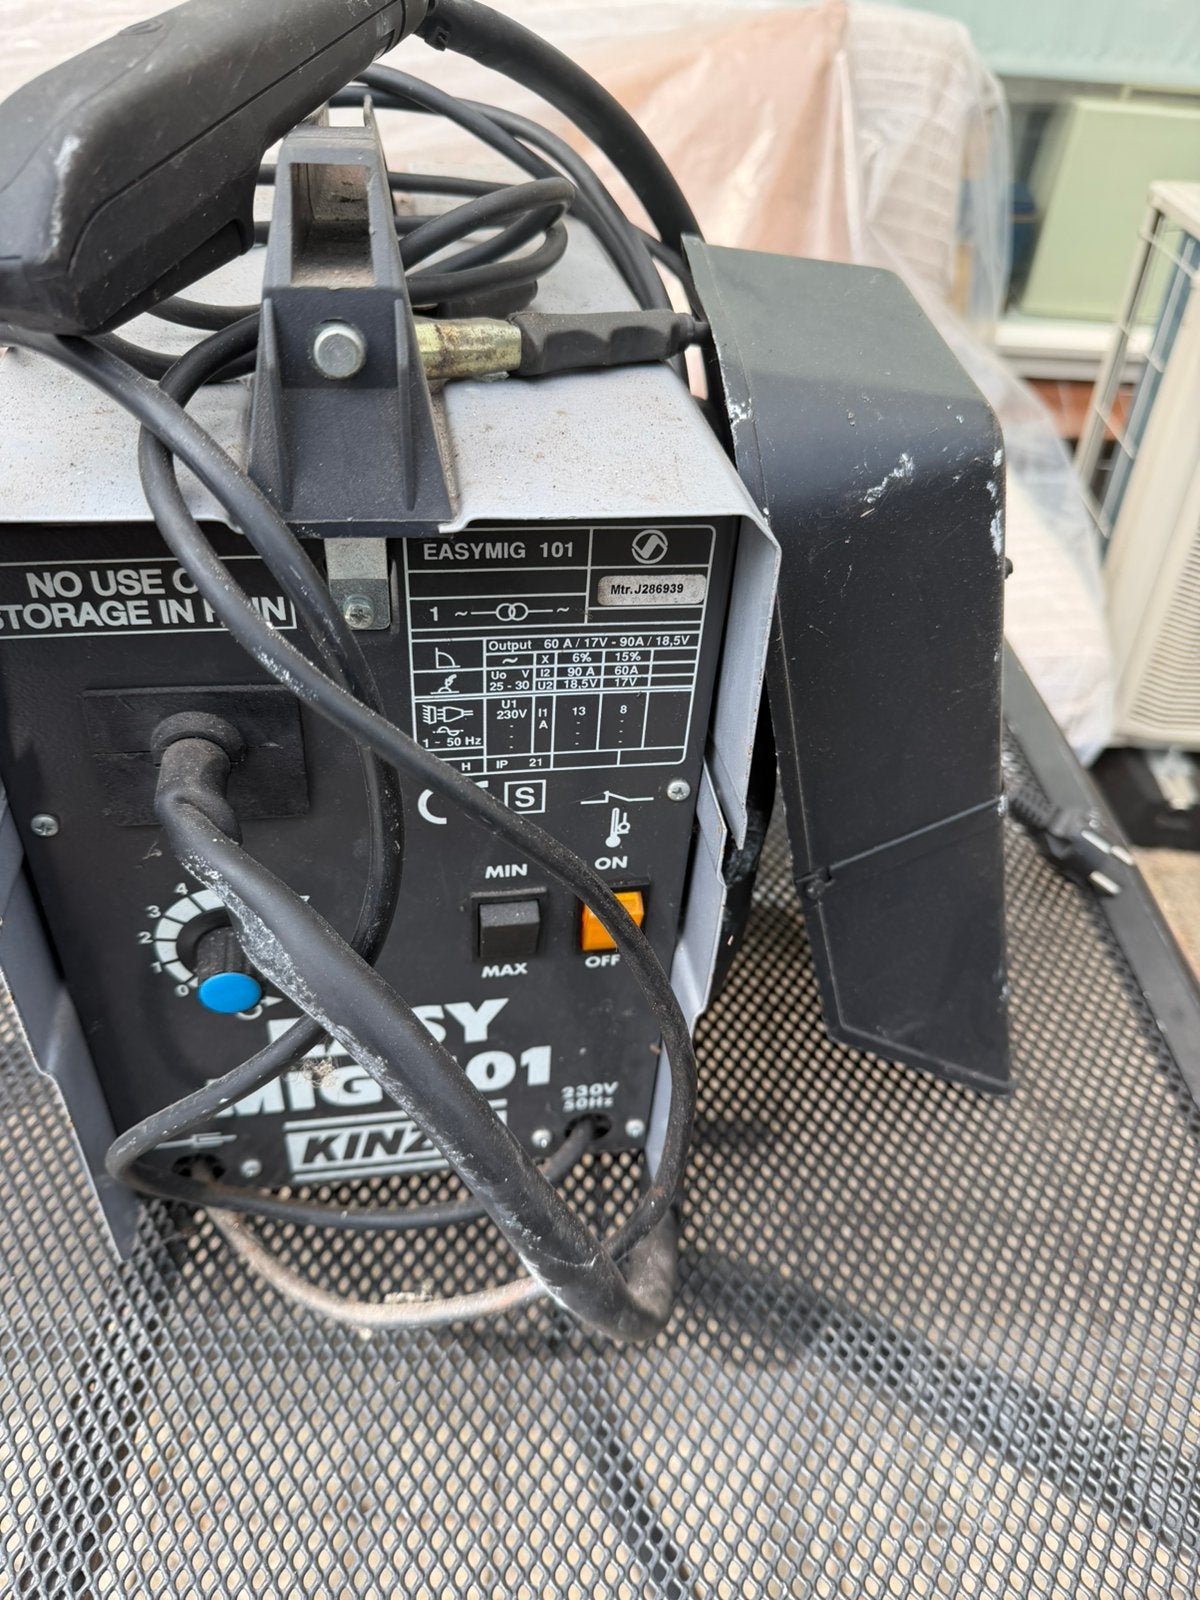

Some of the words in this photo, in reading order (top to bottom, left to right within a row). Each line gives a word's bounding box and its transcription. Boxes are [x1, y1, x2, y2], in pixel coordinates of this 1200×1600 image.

[423, 541, 526, 561] EASYMIG
[539, 541, 574, 559] 101
[26, 570, 83, 598] NO
[90, 568, 163, 597] USE
[172, 567, 199, 594] O
[610, 582, 684, 595] Mtr.J286939
[0, 599, 153, 630] TORAGE
[159, 598, 196, 624] IN
[429, 606, 439, 622] 1
[488, 640, 532, 653] Output
[543, 639, 560, 649] 60
[562, 638, 573, 649] A
[584, 637, 608, 648] 17V
[619, 636, 645, 647] 90A
[656, 635, 690, 648] 18,5V
[541, 654, 550, 664] X
[572, 652, 592, 663] 6%
[615, 651, 642, 662] 15%
[490, 670, 507, 680] Uo
[521, 669, 530, 679] V
[567, 667, 582, 677] 90
[585, 666, 595, 677] A
[614, 665, 639, 676] 60A
[489, 681, 504, 692] 25
[515, 680, 530, 690] 30
[537, 681, 553, 690] U2
[614, 677, 638, 688] 17V
[501, 699, 517, 709] U1
[619, 704, 628, 715] 8
[496, 709, 527, 720] 230V
[572, 706, 586, 716] 13
[538, 720, 548, 729] A
[422, 738, 429, 748] 1
[446, 737, 461, 747] 50
[465, 735, 482, 746] Hz
[461, 762, 471, 771] H
[496, 760, 508, 769] IP
[529, 758, 542, 767] 21
[514, 786, 536, 808] S
[594, 855, 628, 870] ON
[485, 863, 528, 879] MIN
[174, 882, 188, 895] 4
[146, 905, 162, 918] 3
[137, 931, 154, 944] 2
[151, 961, 162, 974] 1
[585, 954, 620, 968] OFF
[481, 962, 528, 978] MAX
[560, 1081, 619, 1100] 230V
